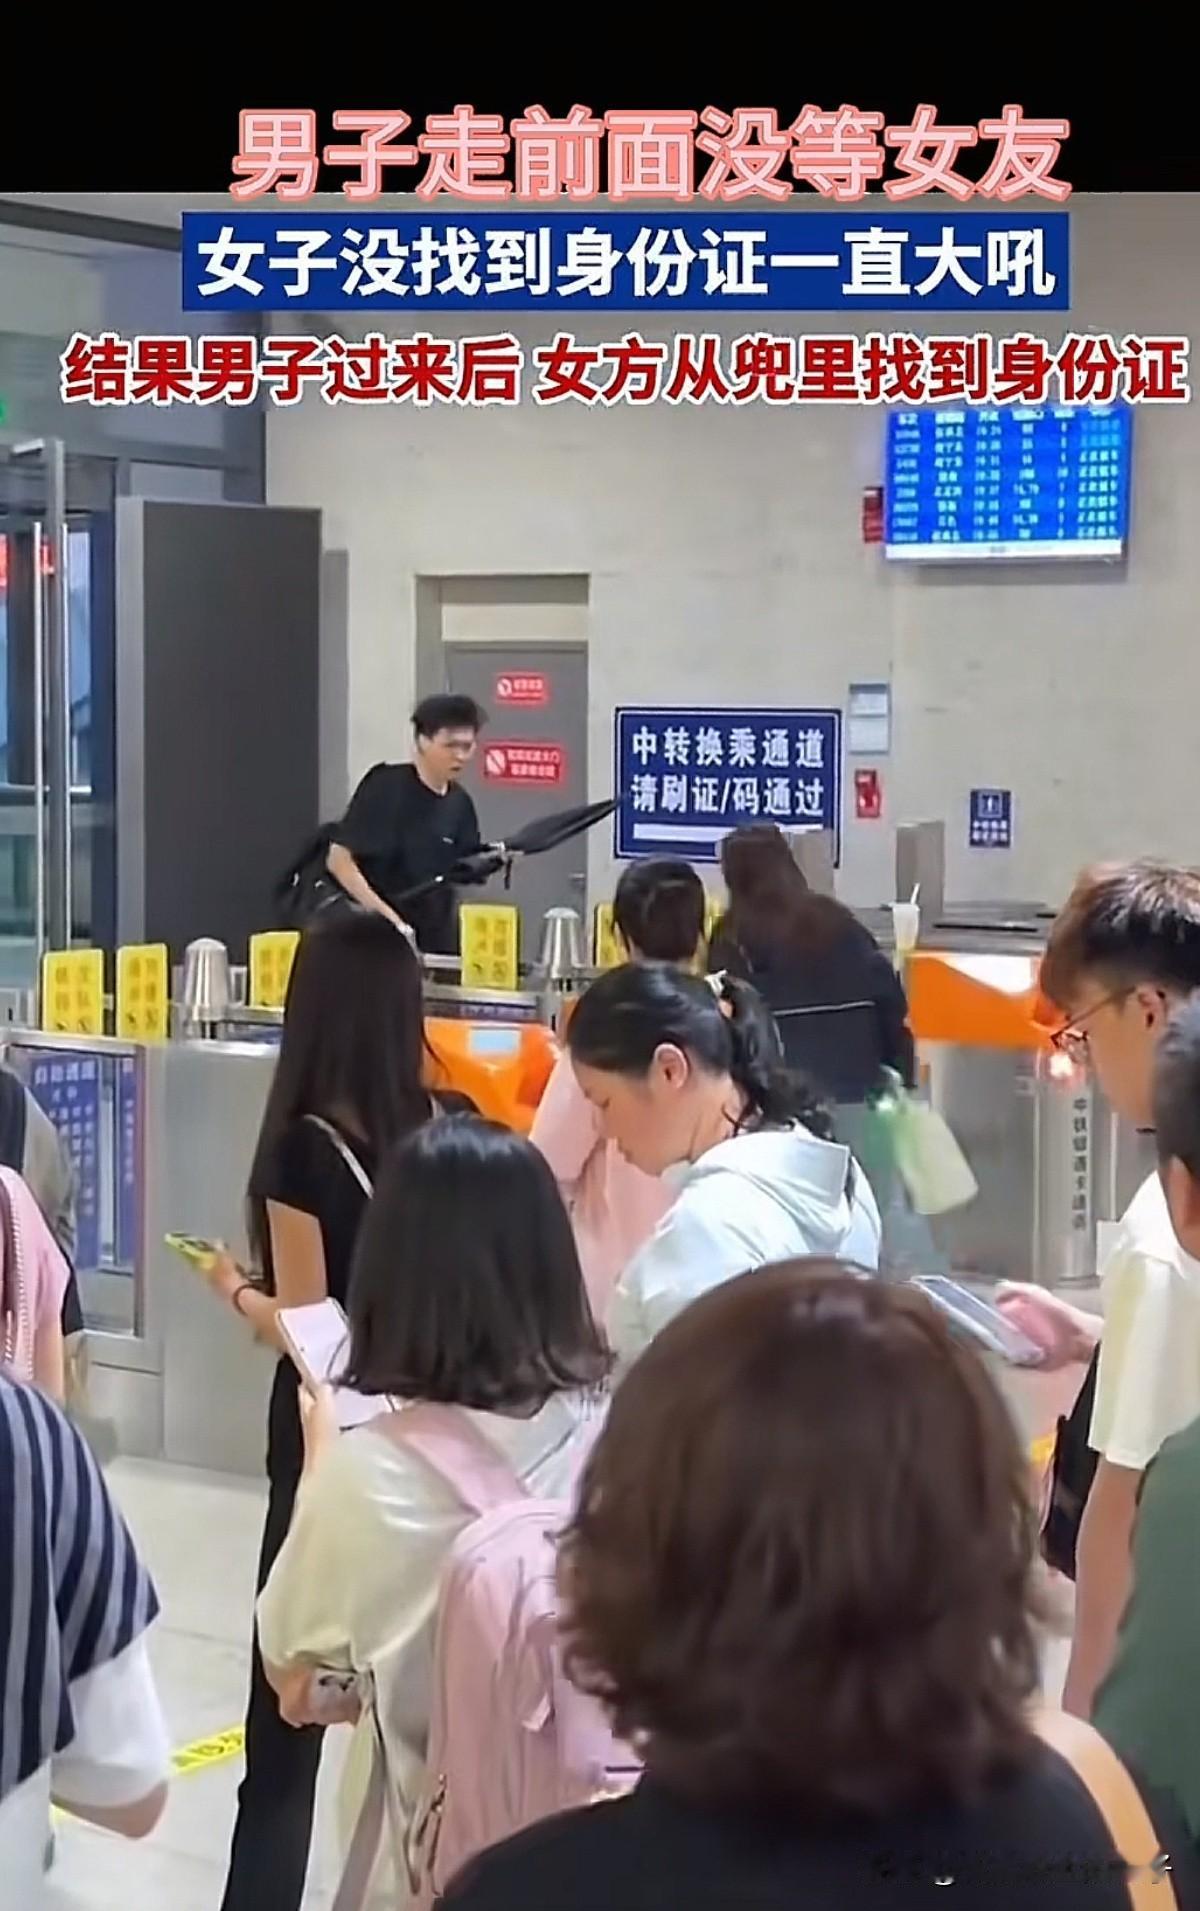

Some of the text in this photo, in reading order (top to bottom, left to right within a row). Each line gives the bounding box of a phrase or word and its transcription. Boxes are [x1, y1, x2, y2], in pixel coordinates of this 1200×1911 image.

[632, 726, 825, 768] 中转换乘通道
[630, 774, 825, 817] 请刷证/码通过
